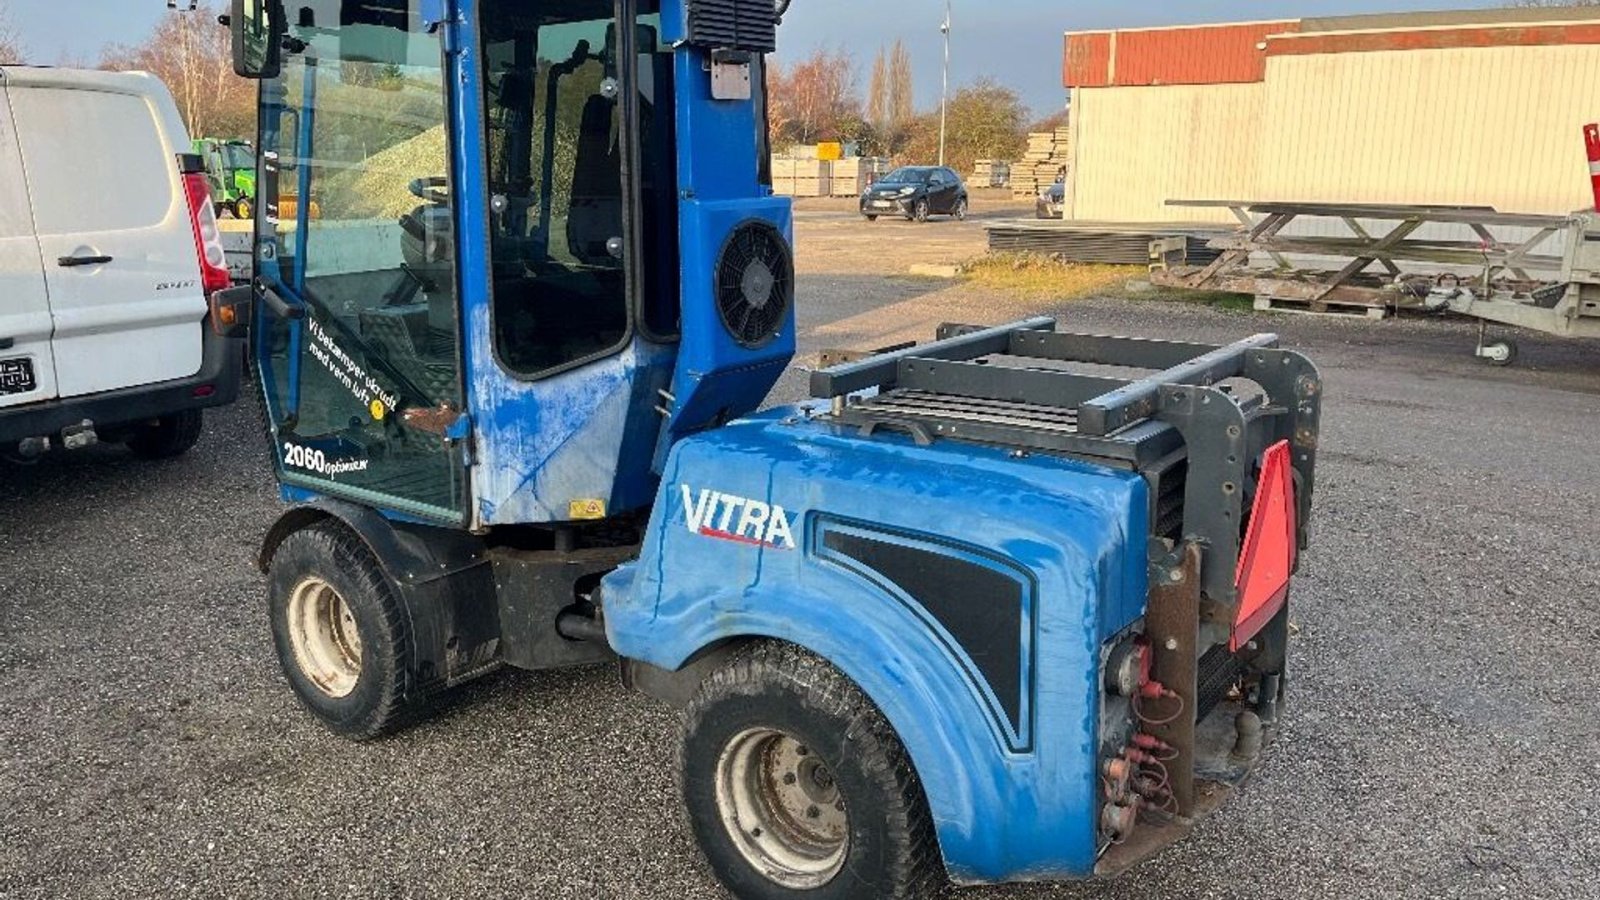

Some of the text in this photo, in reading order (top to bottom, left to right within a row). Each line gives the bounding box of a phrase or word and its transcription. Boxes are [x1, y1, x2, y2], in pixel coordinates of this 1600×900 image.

[309, 317, 319, 335] Vi
[309, 342, 329, 367] med
[284, 442, 325, 473] 2060
[681, 484, 795, 548] VITRA
